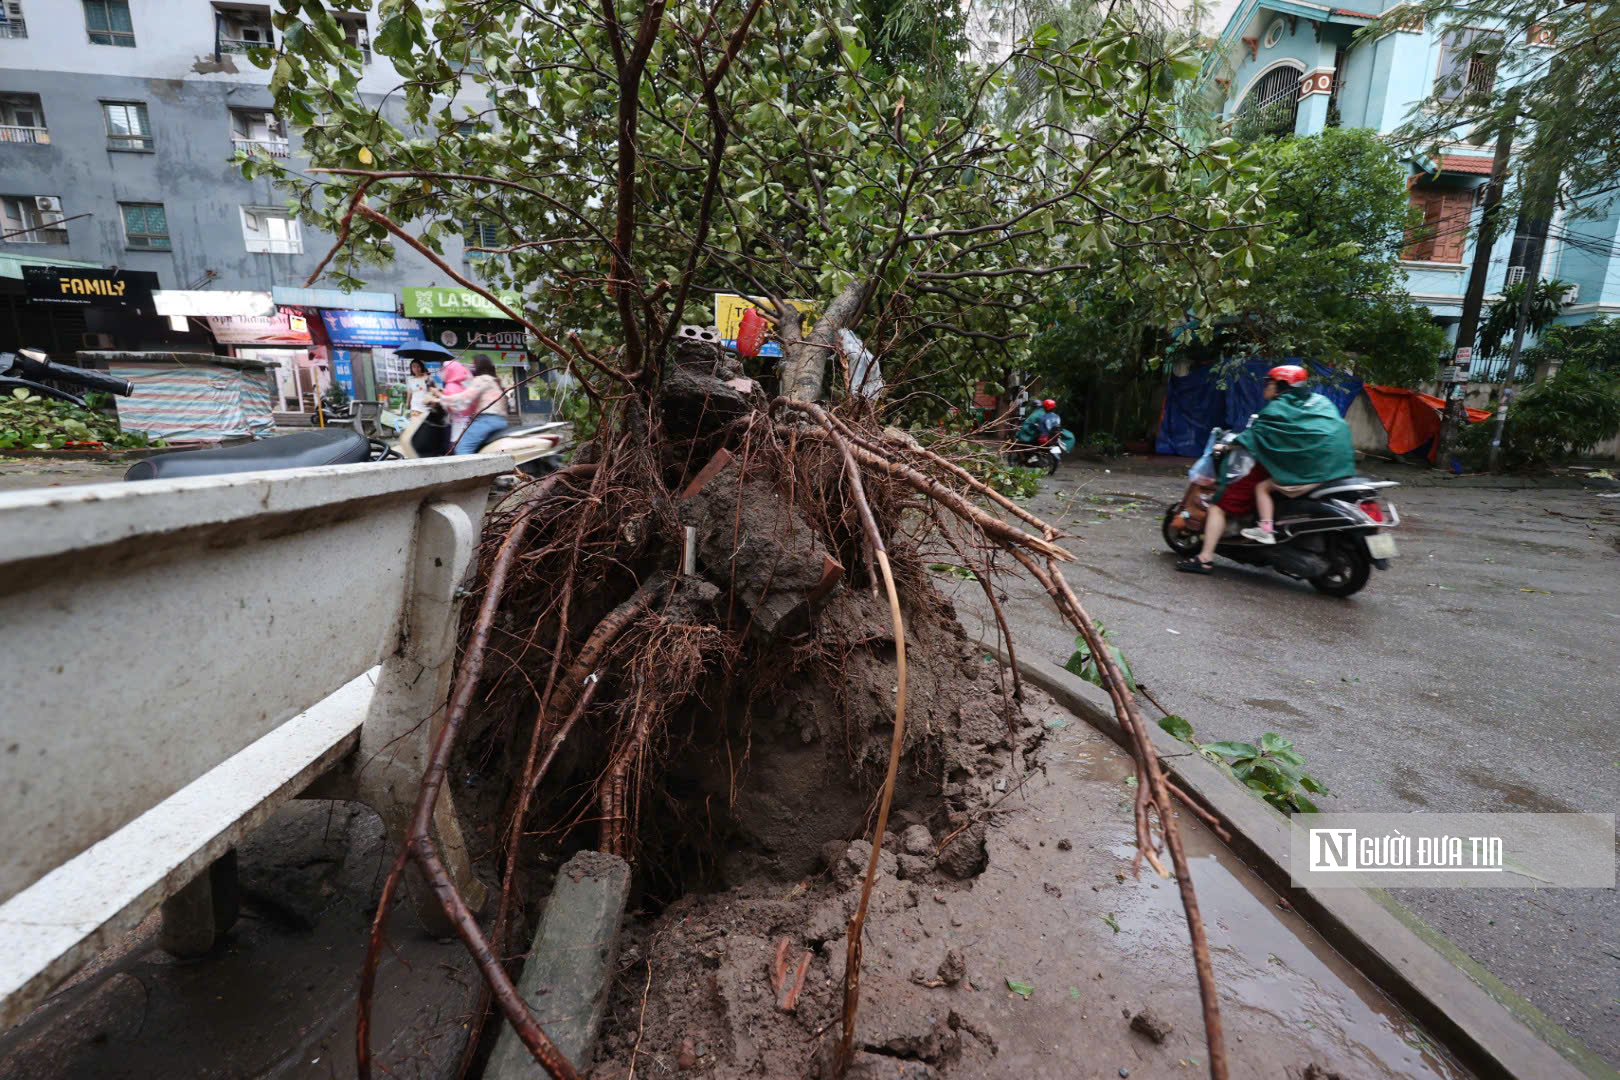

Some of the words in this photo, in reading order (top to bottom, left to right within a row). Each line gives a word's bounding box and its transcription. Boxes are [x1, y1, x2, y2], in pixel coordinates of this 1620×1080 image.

[59, 277, 126, 297] FAMILY
[439, 293, 459, 307] LA
[466, 331, 483, 344] LA
